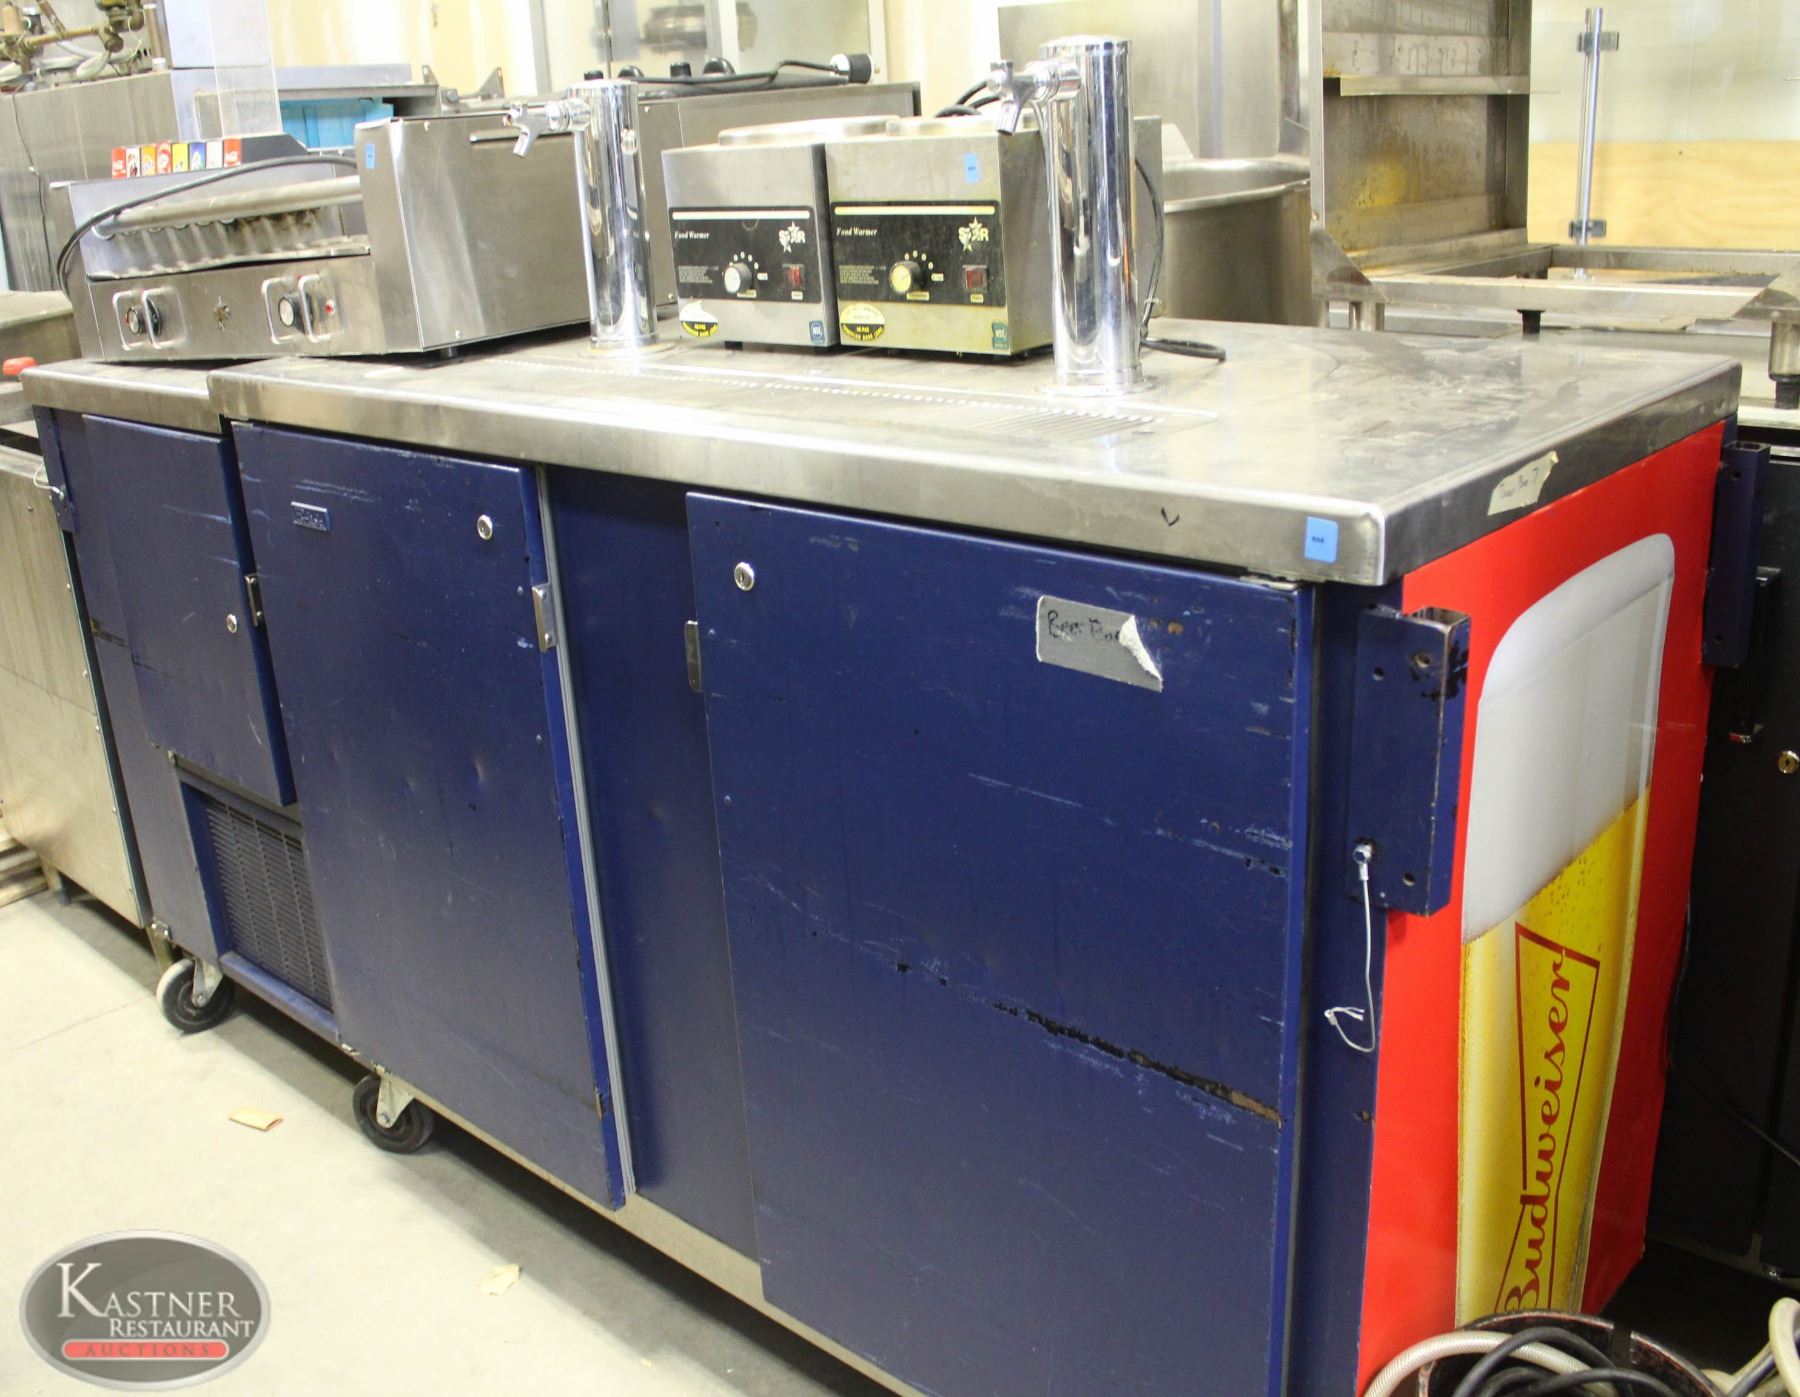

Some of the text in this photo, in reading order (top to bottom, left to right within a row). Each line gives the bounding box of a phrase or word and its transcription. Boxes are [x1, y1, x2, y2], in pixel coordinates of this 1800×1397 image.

[674, 231, 710, 239] Food Warmer
[836, 227, 878, 236] Food Warmer
[1505, 949, 1570, 1311] Budweiser
